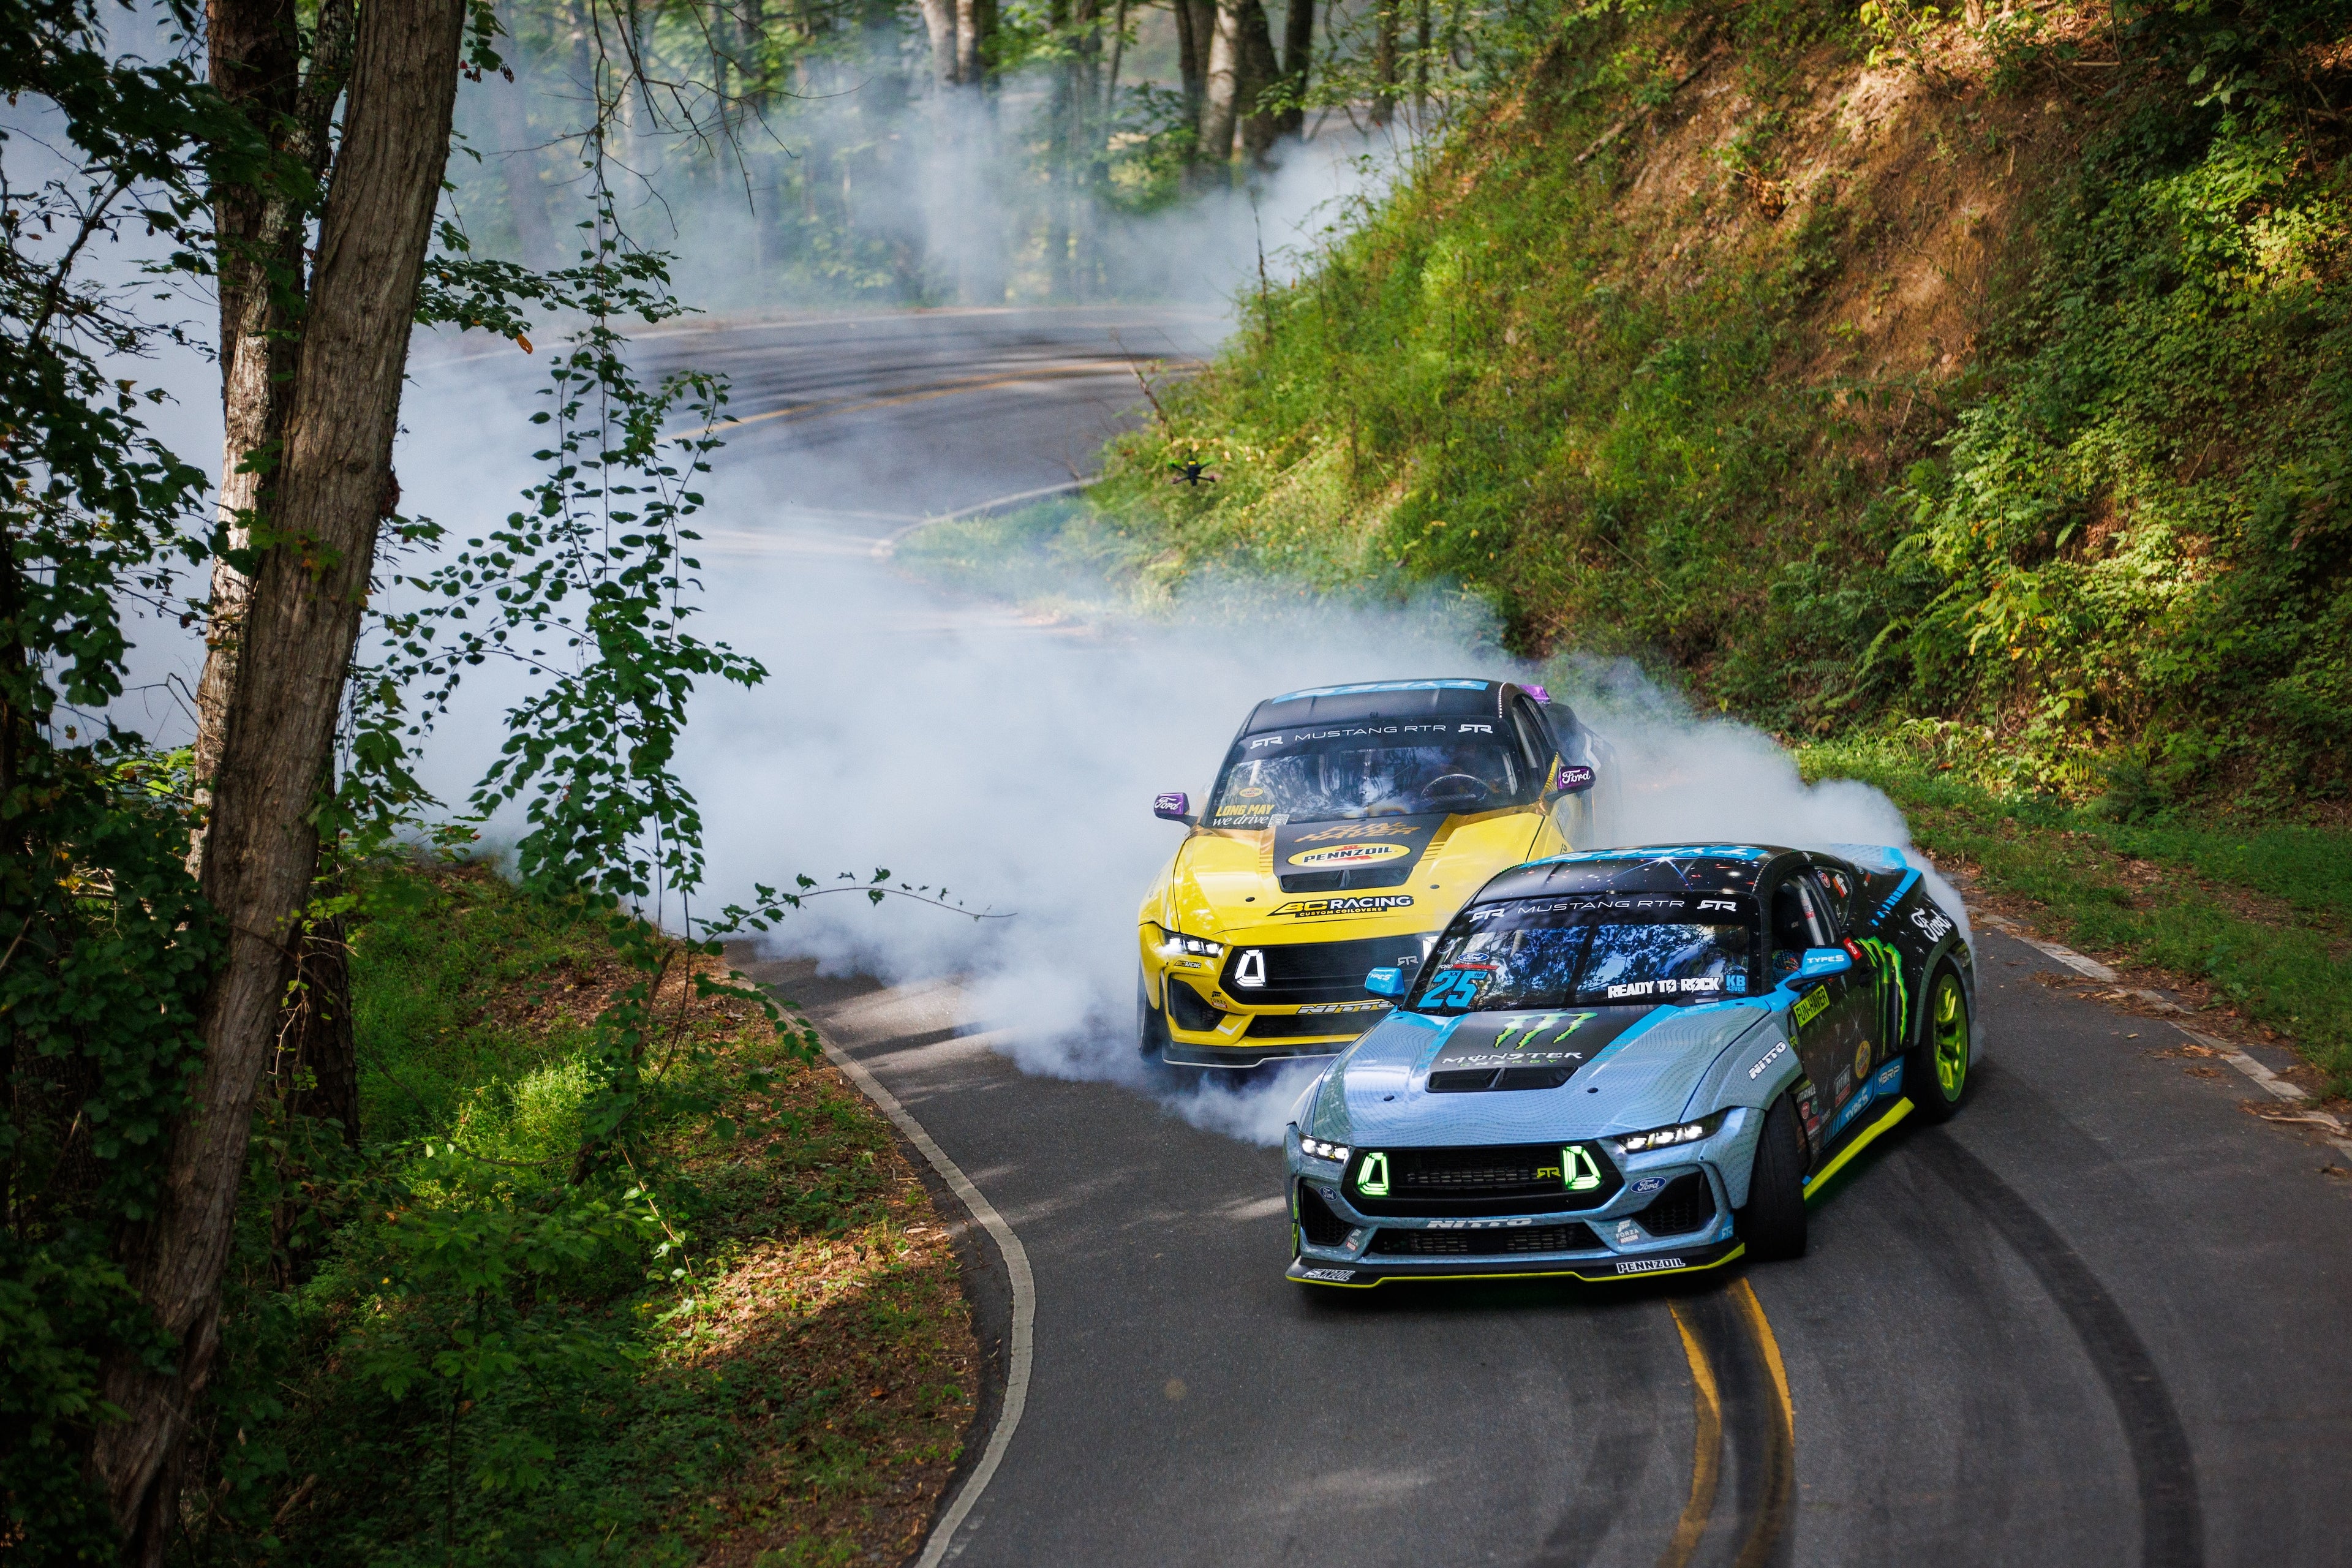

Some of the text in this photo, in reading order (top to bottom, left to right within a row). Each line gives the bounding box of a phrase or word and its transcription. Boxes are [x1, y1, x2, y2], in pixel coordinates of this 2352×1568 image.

[1250, 736, 1283, 749] RTR
[1295, 726, 1397, 741] MUSTANG
[1458, 724, 1493, 734] RTR
[1562, 769, 1591, 784] Ford
[1155, 797, 1182, 810] Ford
[1215, 804, 1275, 817] LONG MAY
[1213, 814, 1269, 827] we drive
[1303, 846, 1393, 863] PENNZOIL
[1274, 896, 1412, 914] BC RACING
[1469, 908, 1504, 922] RTR
[1518, 900, 1630, 914] MUSTANG
[1697, 900, 1736, 911] RTR
[1911, 908, 1952, 943] Ford
[1397, 956, 1419, 966] RTR
[1726, 974, 1746, 986] KB
[1417, 970, 1488, 1008] 25
[1607, 977, 1721, 999] READY TO ROCK
[1796, 988, 1828, 1023] FUN-HAVER
[1748, 1041, 1787, 1080] NITTO
[1878, 1065, 1901, 1088] MBRP
[1796, 1084, 1816, 1103] MAHLE
[1537, 1167, 1561, 1178] RTR
[1637, 1179, 1659, 1192] Ford
[1322, 1188, 1335, 1199] Ford
[1427, 1218, 1532, 1228] NITTO
[1616, 1229, 1639, 1239] FORZA
[1616, 1257, 1686, 1273] PENNZOIL
[1302, 1268, 1356, 1281] PENNZOIL
